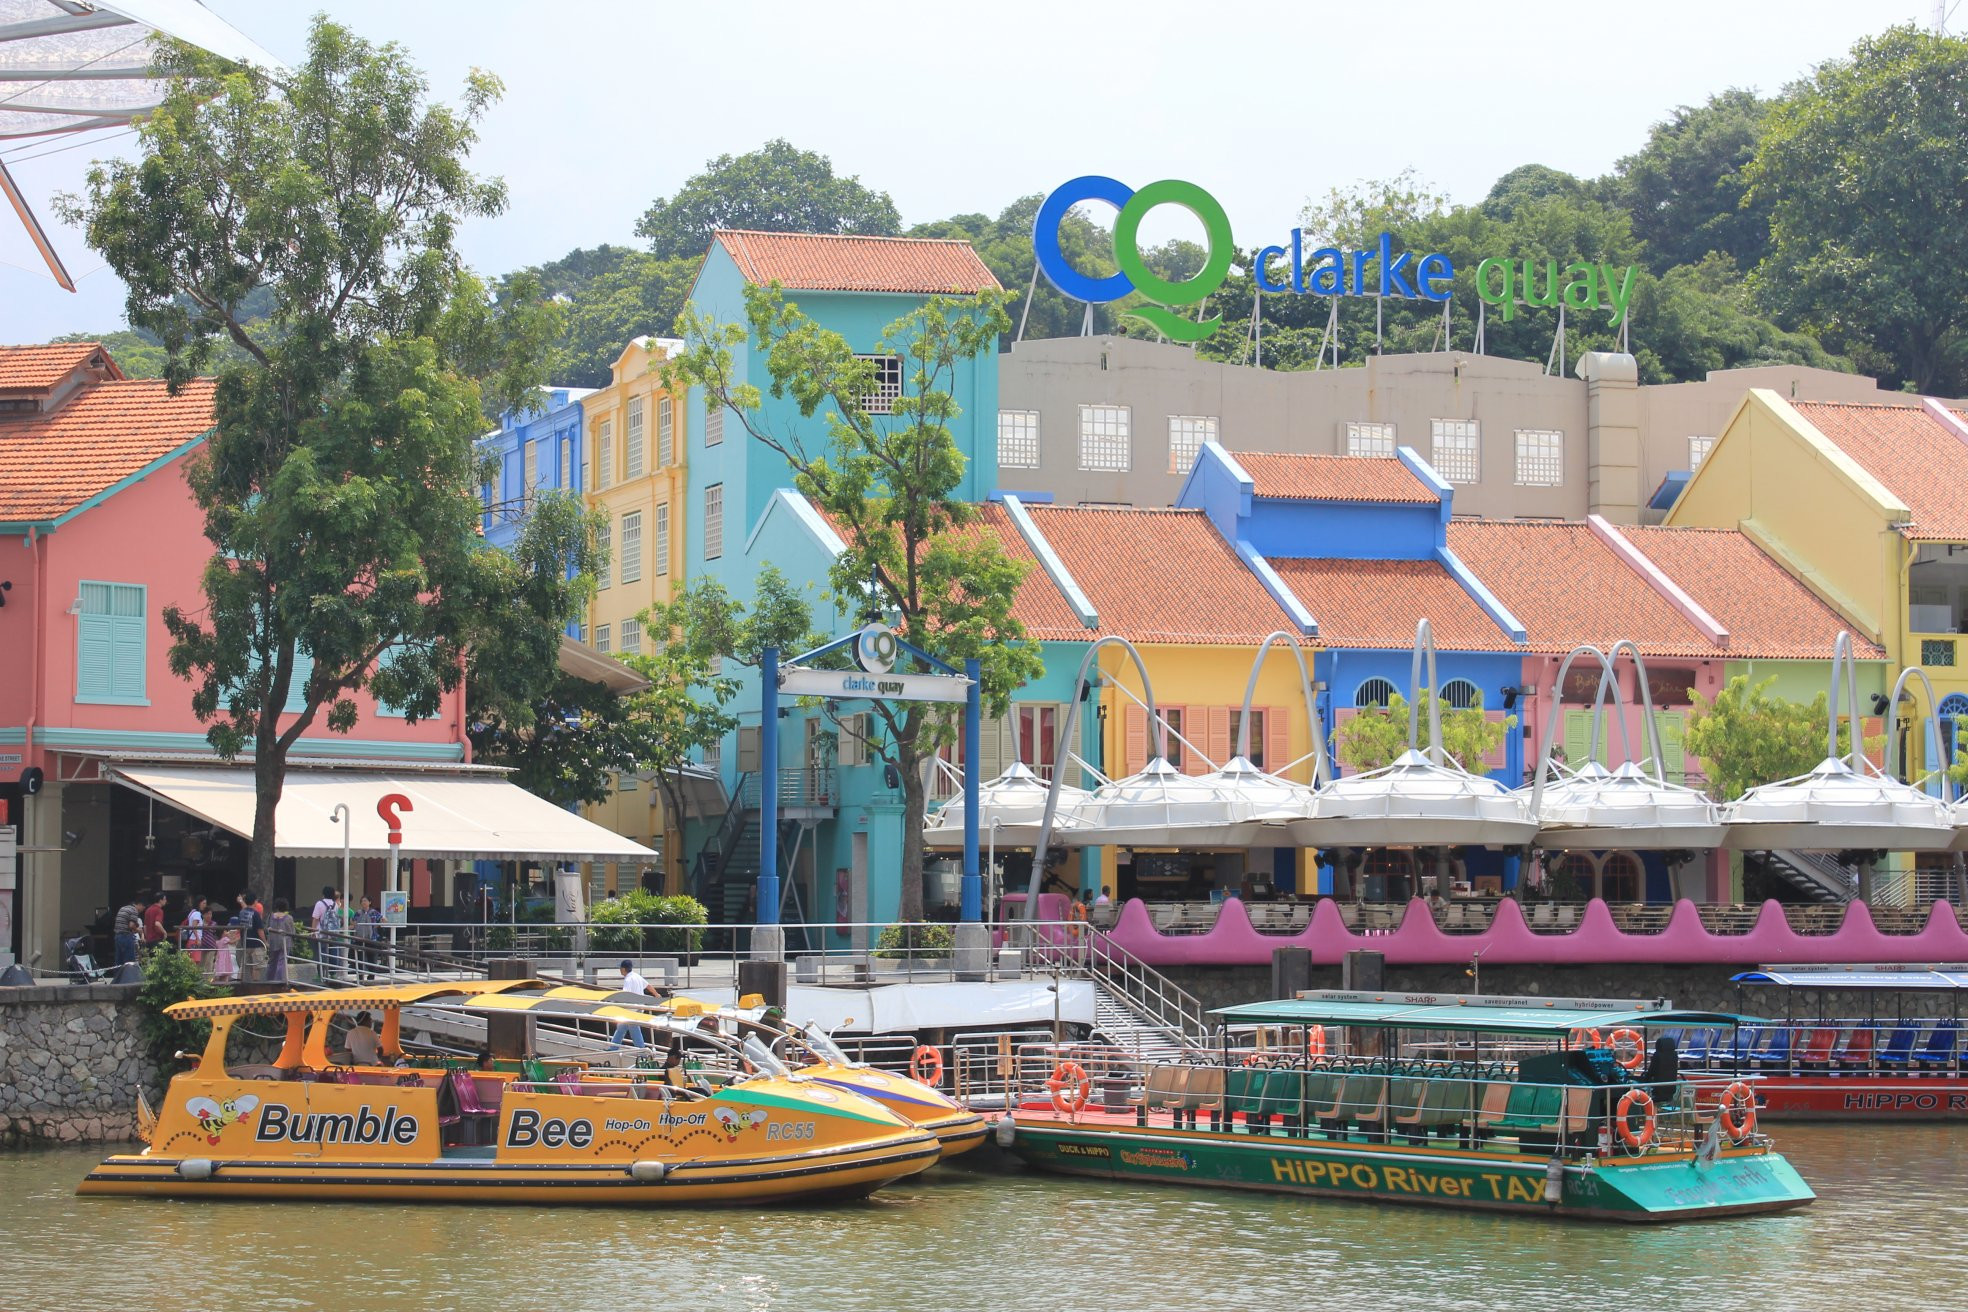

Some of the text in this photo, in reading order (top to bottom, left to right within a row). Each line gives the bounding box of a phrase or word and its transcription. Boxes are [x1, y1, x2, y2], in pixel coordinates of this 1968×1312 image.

[1033, 174, 1639, 342] CQ clarke quay
[842, 675, 904, 696] clarke quay
[1404, 995, 1437, 1004] SHARP
[1843, 1093, 1938, 1110] HiPPO
[255, 1103, 595, 1148] Bumble Bee
[604, 1112, 707, 1132] Hop-On Hop-Off
[766, 1121, 815, 1140] RC55
[1270, 1158, 1556, 1203] HiPPO River TAX
[1567, 1181, 1600, 1197] RC 21
